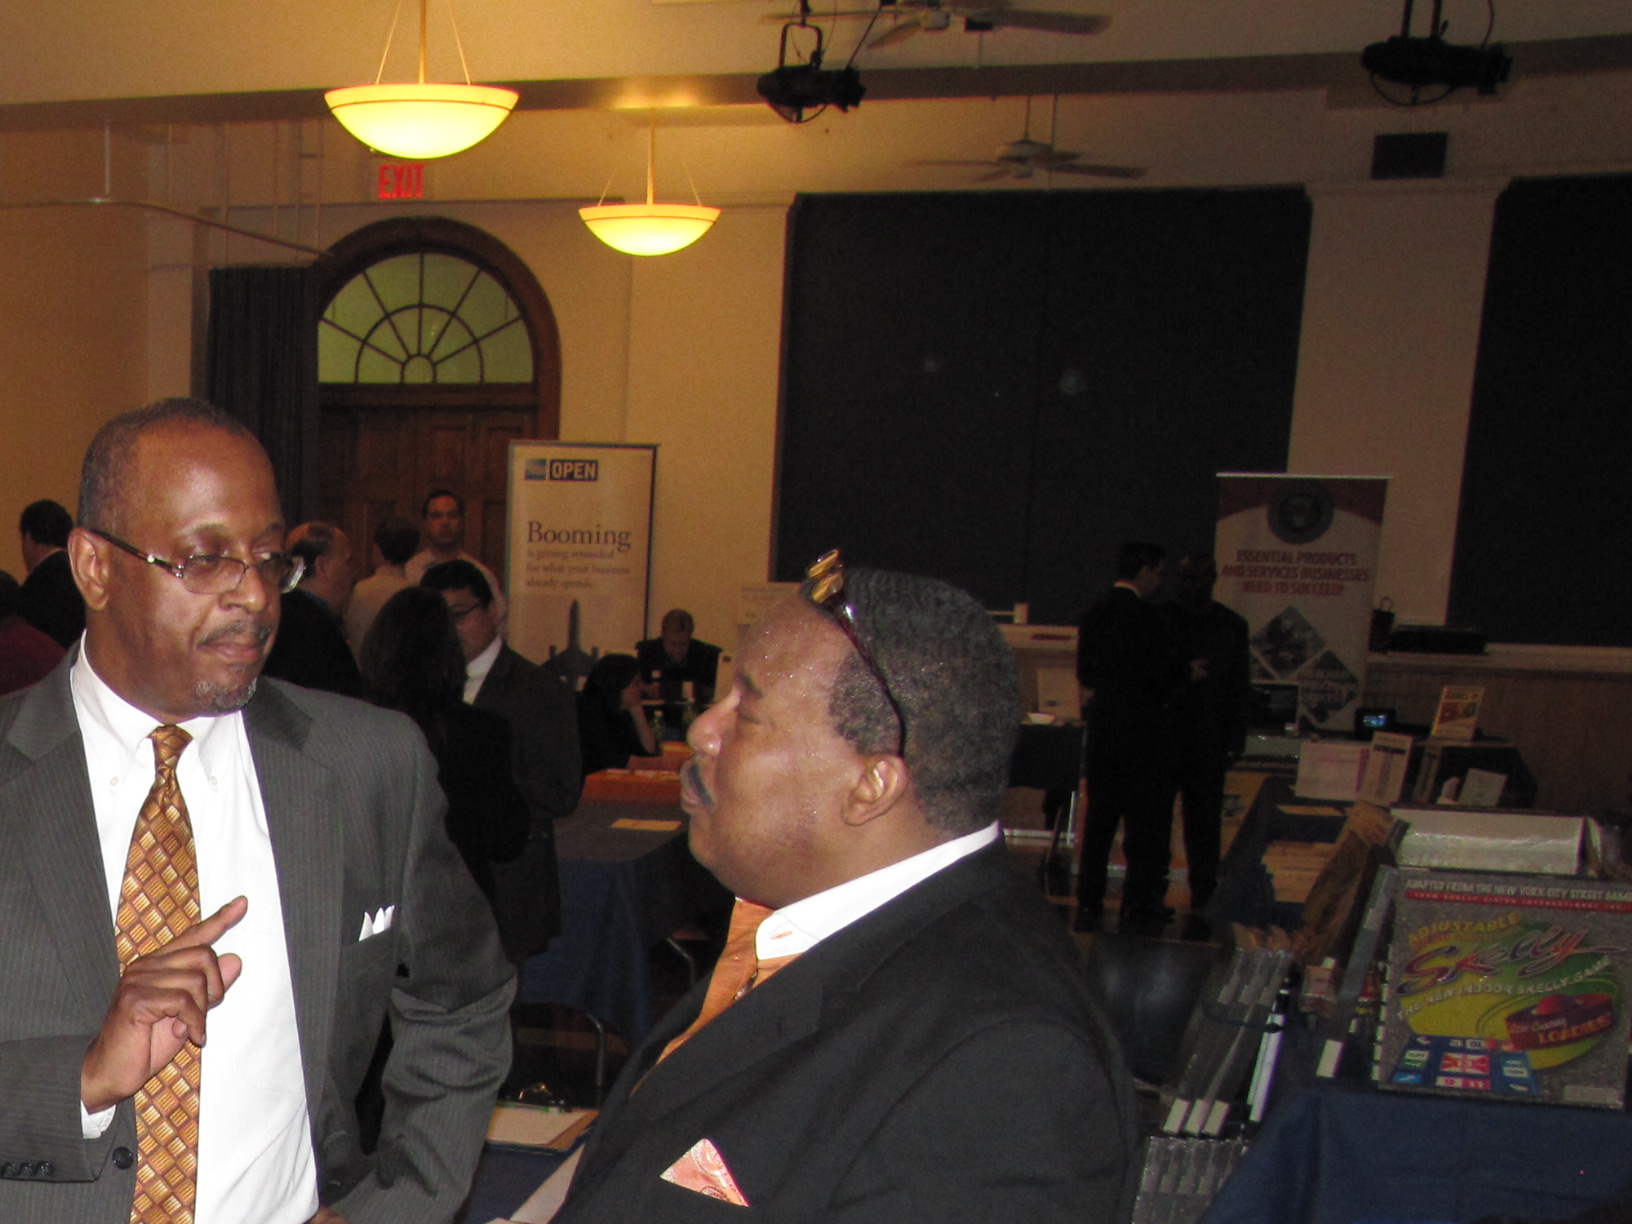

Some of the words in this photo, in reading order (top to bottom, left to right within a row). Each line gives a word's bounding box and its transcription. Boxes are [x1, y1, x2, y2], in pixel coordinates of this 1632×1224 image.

[378, 163, 425, 199] EXIT
[551, 461, 597, 479] OPEN
[528, 520, 632, 553] Booming
[1237, 550, 1293, 564] ESSENTIAL
[1296, 552, 1357, 566] PRODUCTS
[1221, 565, 1244, 578] AND
[1246, 566, 1298, 580] SERVICES
[1300, 568, 1370, 582] BUSINESSES
[1242, 581, 1272, 593] NEED
[1274, 582, 1289, 594] TO
[1494, 884, 1517, 897] NEW
[1519, 885, 1546, 899] YORK
[1569, 889, 1604, 901] STREET
[1409, 912, 1521, 946] ADJUSTABLE
[1394, 926, 1627, 995] Skelly
[1515, 976, 1569, 995] SKELLY
